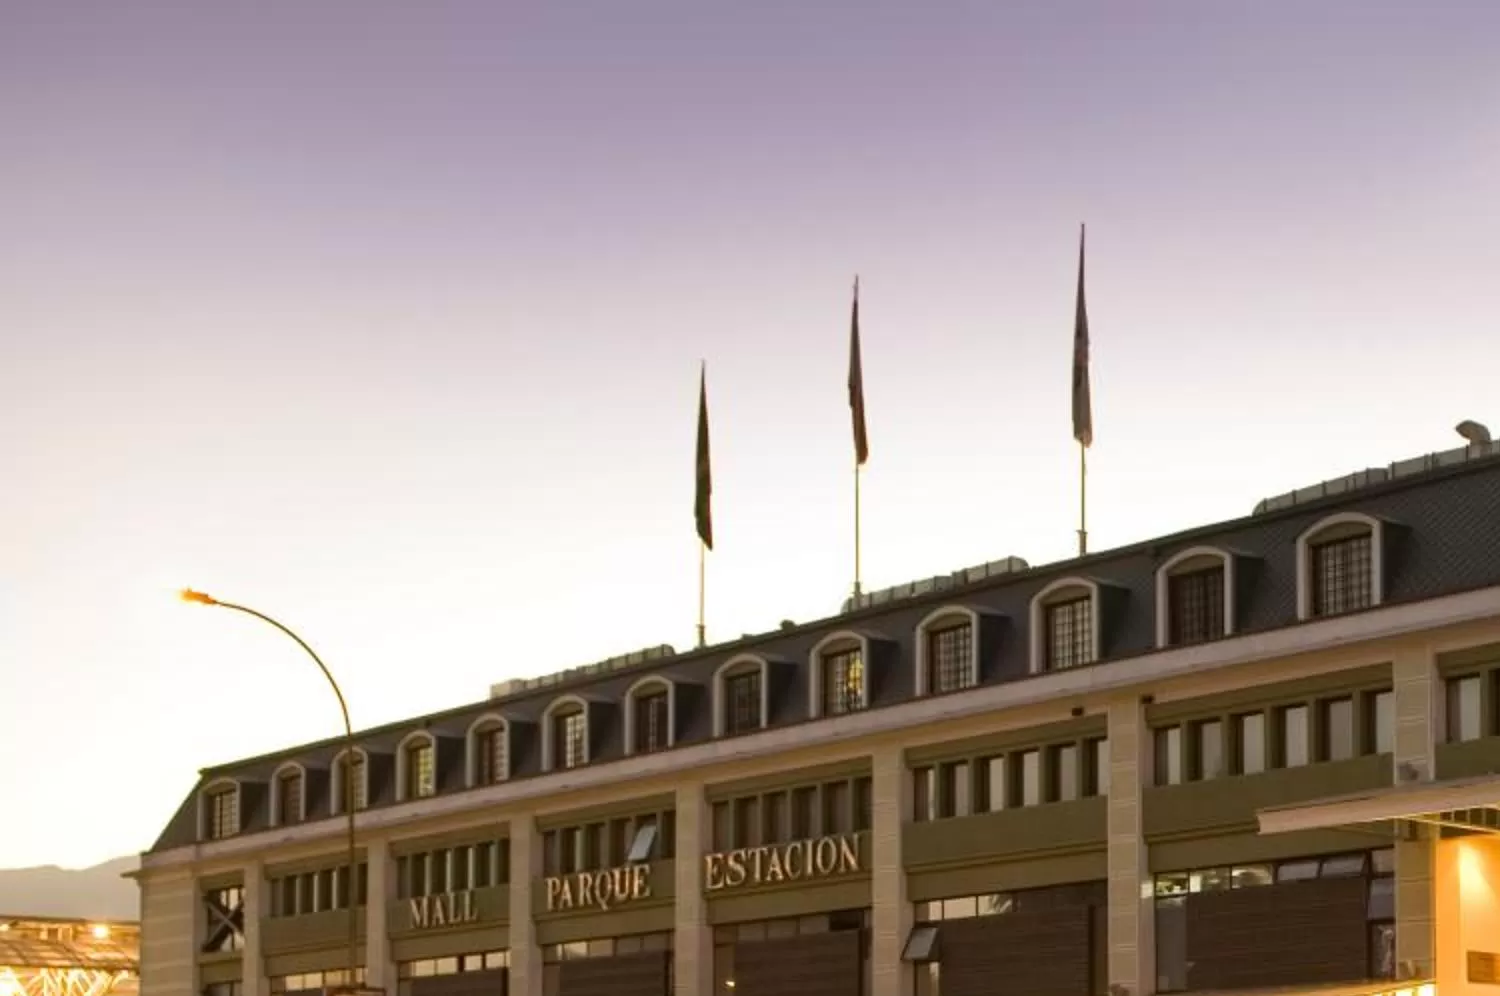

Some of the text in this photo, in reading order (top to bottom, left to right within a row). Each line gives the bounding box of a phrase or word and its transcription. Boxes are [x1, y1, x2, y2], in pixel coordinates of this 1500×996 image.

[409, 833, 860, 928] MALL PARQUE ESTACION
